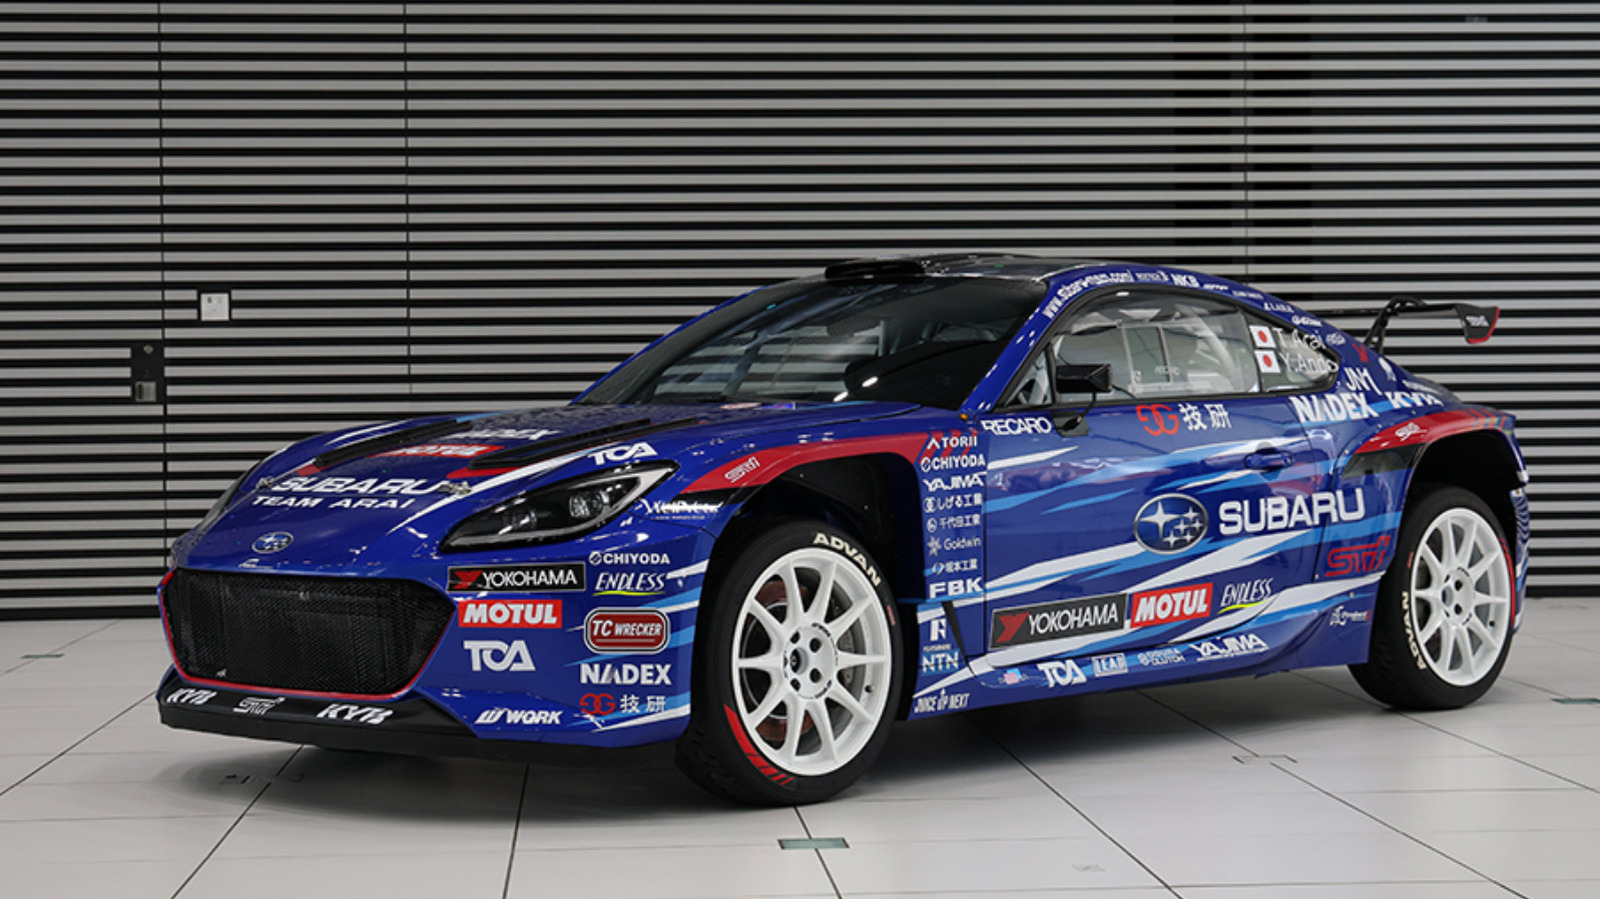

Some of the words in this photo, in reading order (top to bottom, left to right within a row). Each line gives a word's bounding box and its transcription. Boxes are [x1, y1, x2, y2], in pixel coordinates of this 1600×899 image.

[1289, 392, 1379, 423] NADEX
[981, 417, 1051, 435] RECARO
[932, 454, 985, 470] CHIYODA
[271, 477, 444, 494] SUBARU
[252, 496, 323, 508] TEAM
[328, 498, 415, 508] ARAI
[1218, 487, 1366, 536] SUBARU
[602, 552, 671, 565] CHIYODA
[813, 532, 881, 587] ADVAN
[483, 569, 578, 587] YOKOHAMA
[594, 572, 666, 591] ENDLESS
[929, 577, 984, 599] FBK
[1220, 578, 1274, 608] ENDLESS
[463, 603, 558, 624] MOTUL
[1135, 588, 1208, 623] MOTUL
[592, 620, 612, 637] TC
[614, 622, 663, 637] WRECKER
[1028, 603, 1119, 635] YOKOHAMA
[1189, 635, 1269, 657] YAJIMA
[922, 651, 959, 672] NTN
[580, 664, 672, 685] NADEX
[167, 688, 217, 705] KYB
[316, 703, 393, 725] KYB
[506, 711, 563, 725] WORK
